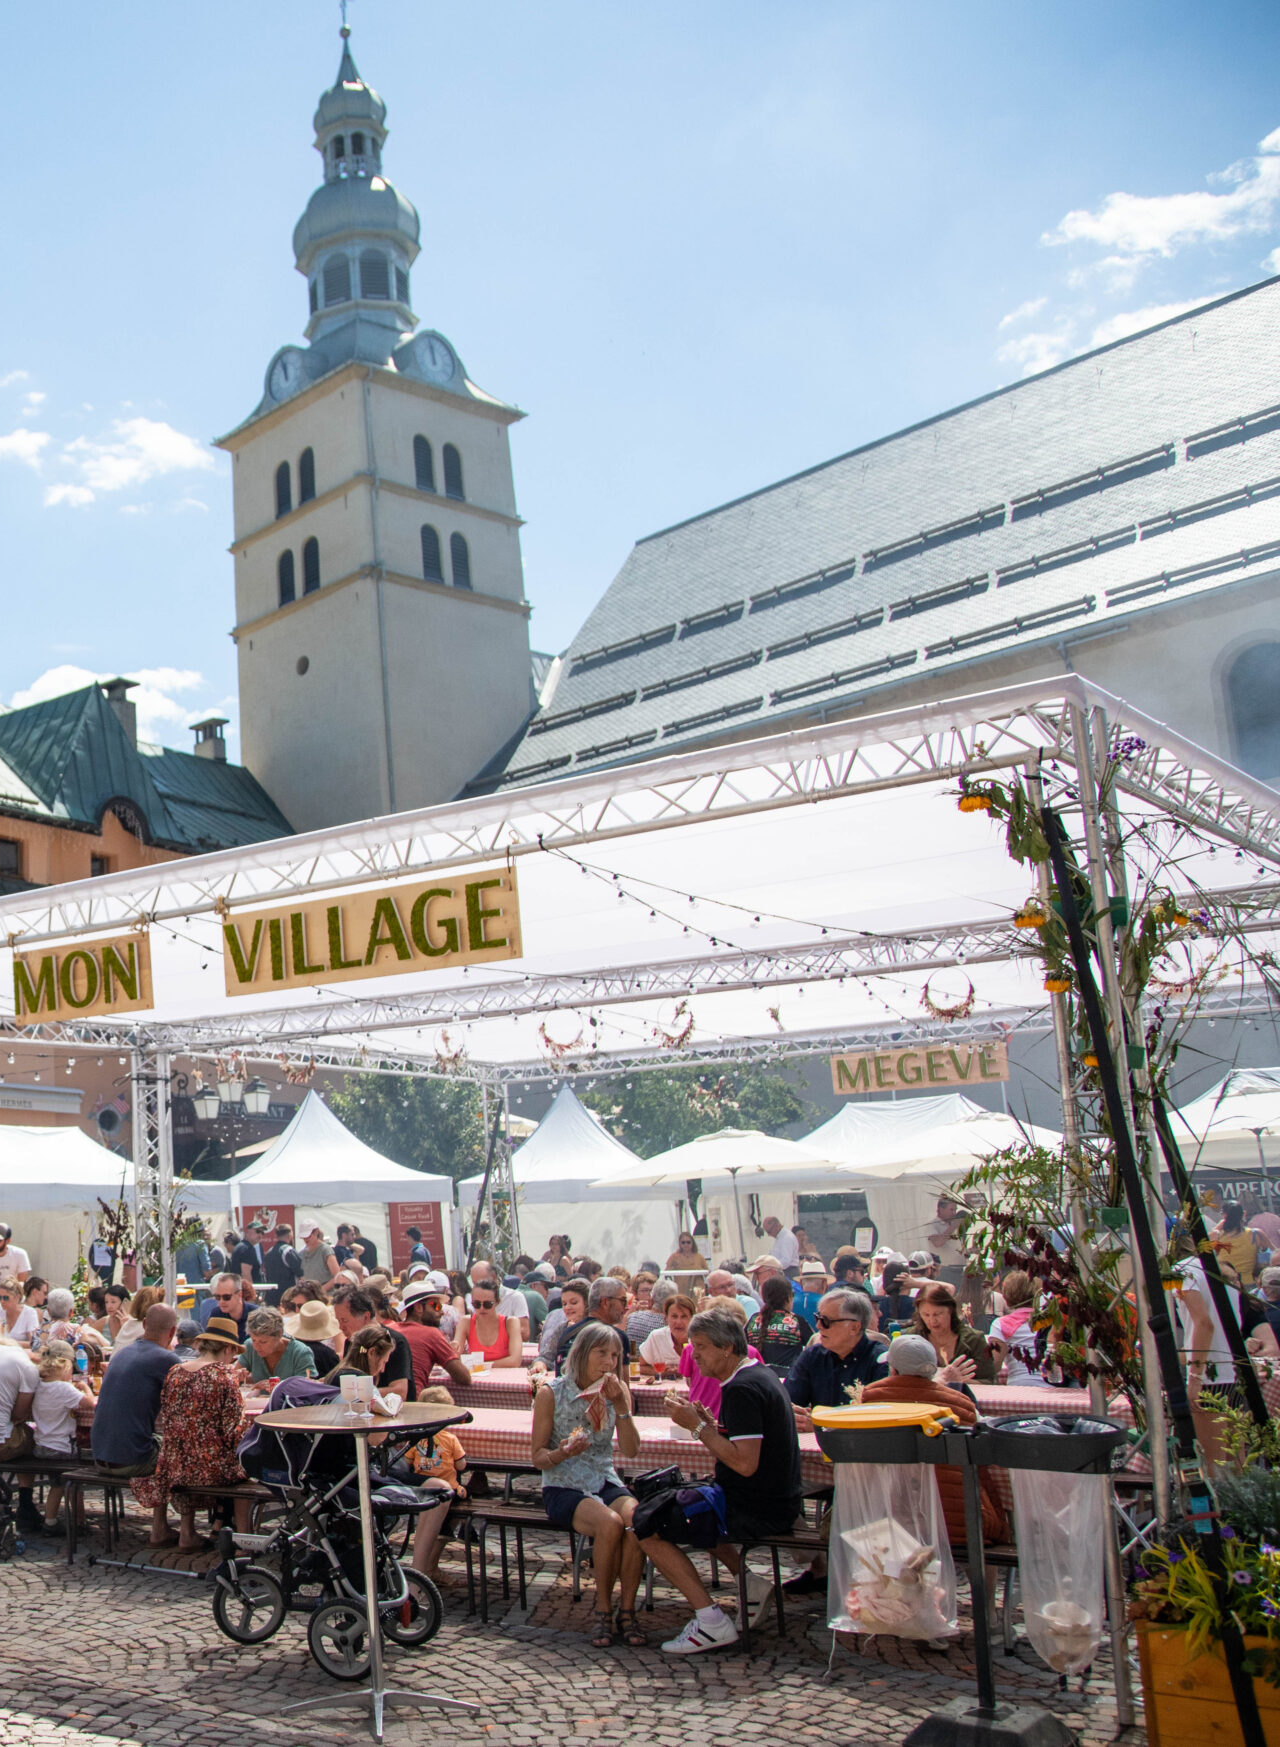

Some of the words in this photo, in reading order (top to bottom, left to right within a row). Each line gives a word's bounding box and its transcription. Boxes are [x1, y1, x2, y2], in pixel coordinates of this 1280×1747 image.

[13, 942, 140, 1015] MON
[223, 878, 510, 983] VILLAGE
[836, 1044, 1001, 1090] MEGEVE
[215, 1101, 287, 1119] ETAANT
[752, 1323, 790, 1332] AGEE
